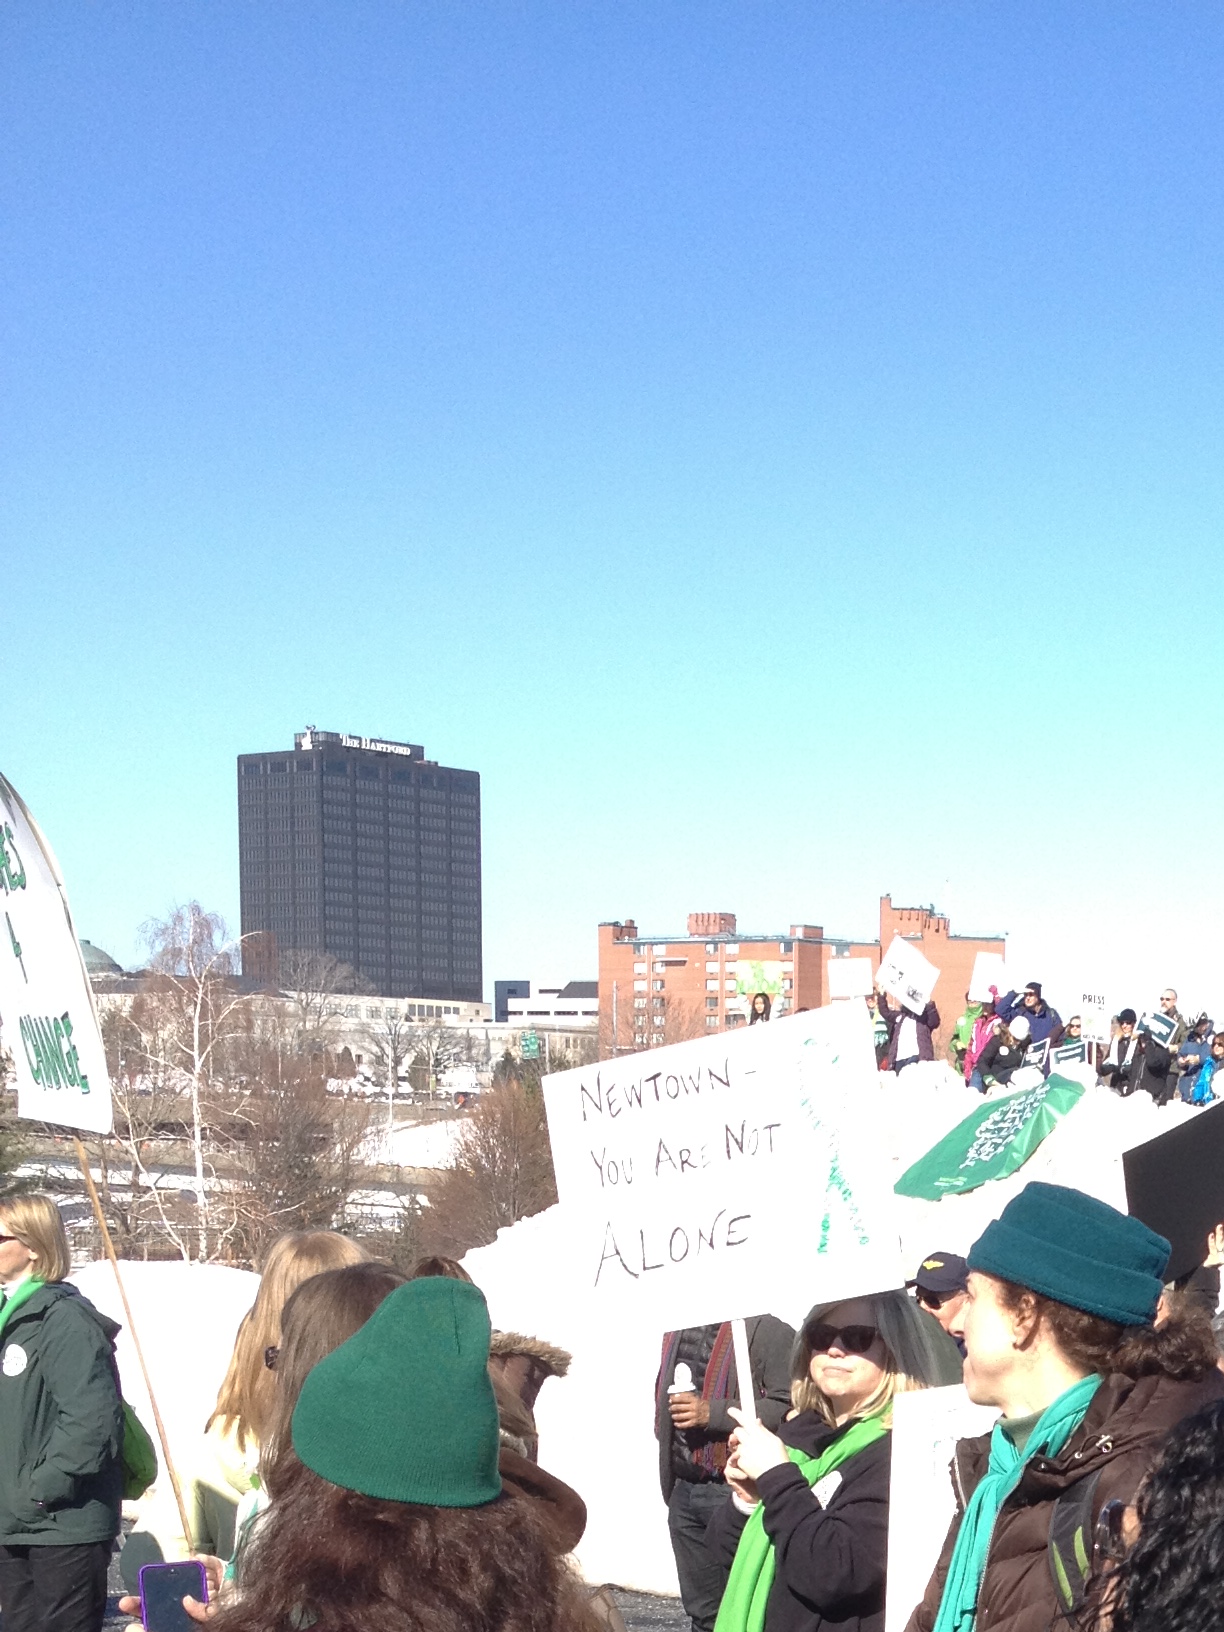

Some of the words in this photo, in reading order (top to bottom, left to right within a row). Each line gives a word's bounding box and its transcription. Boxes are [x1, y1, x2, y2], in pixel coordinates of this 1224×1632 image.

[340, 734, 360, 748] THE
[361, 738, 411, 756] HARTFORD
[580, 1057, 731, 1121] NEWTOWN
[590, 1147, 633, 1188] YOU
[655, 1138, 712, 1177] ARE
[724, 1119, 781, 1160] NOT
[594, 1208, 752, 1287] ALONE
